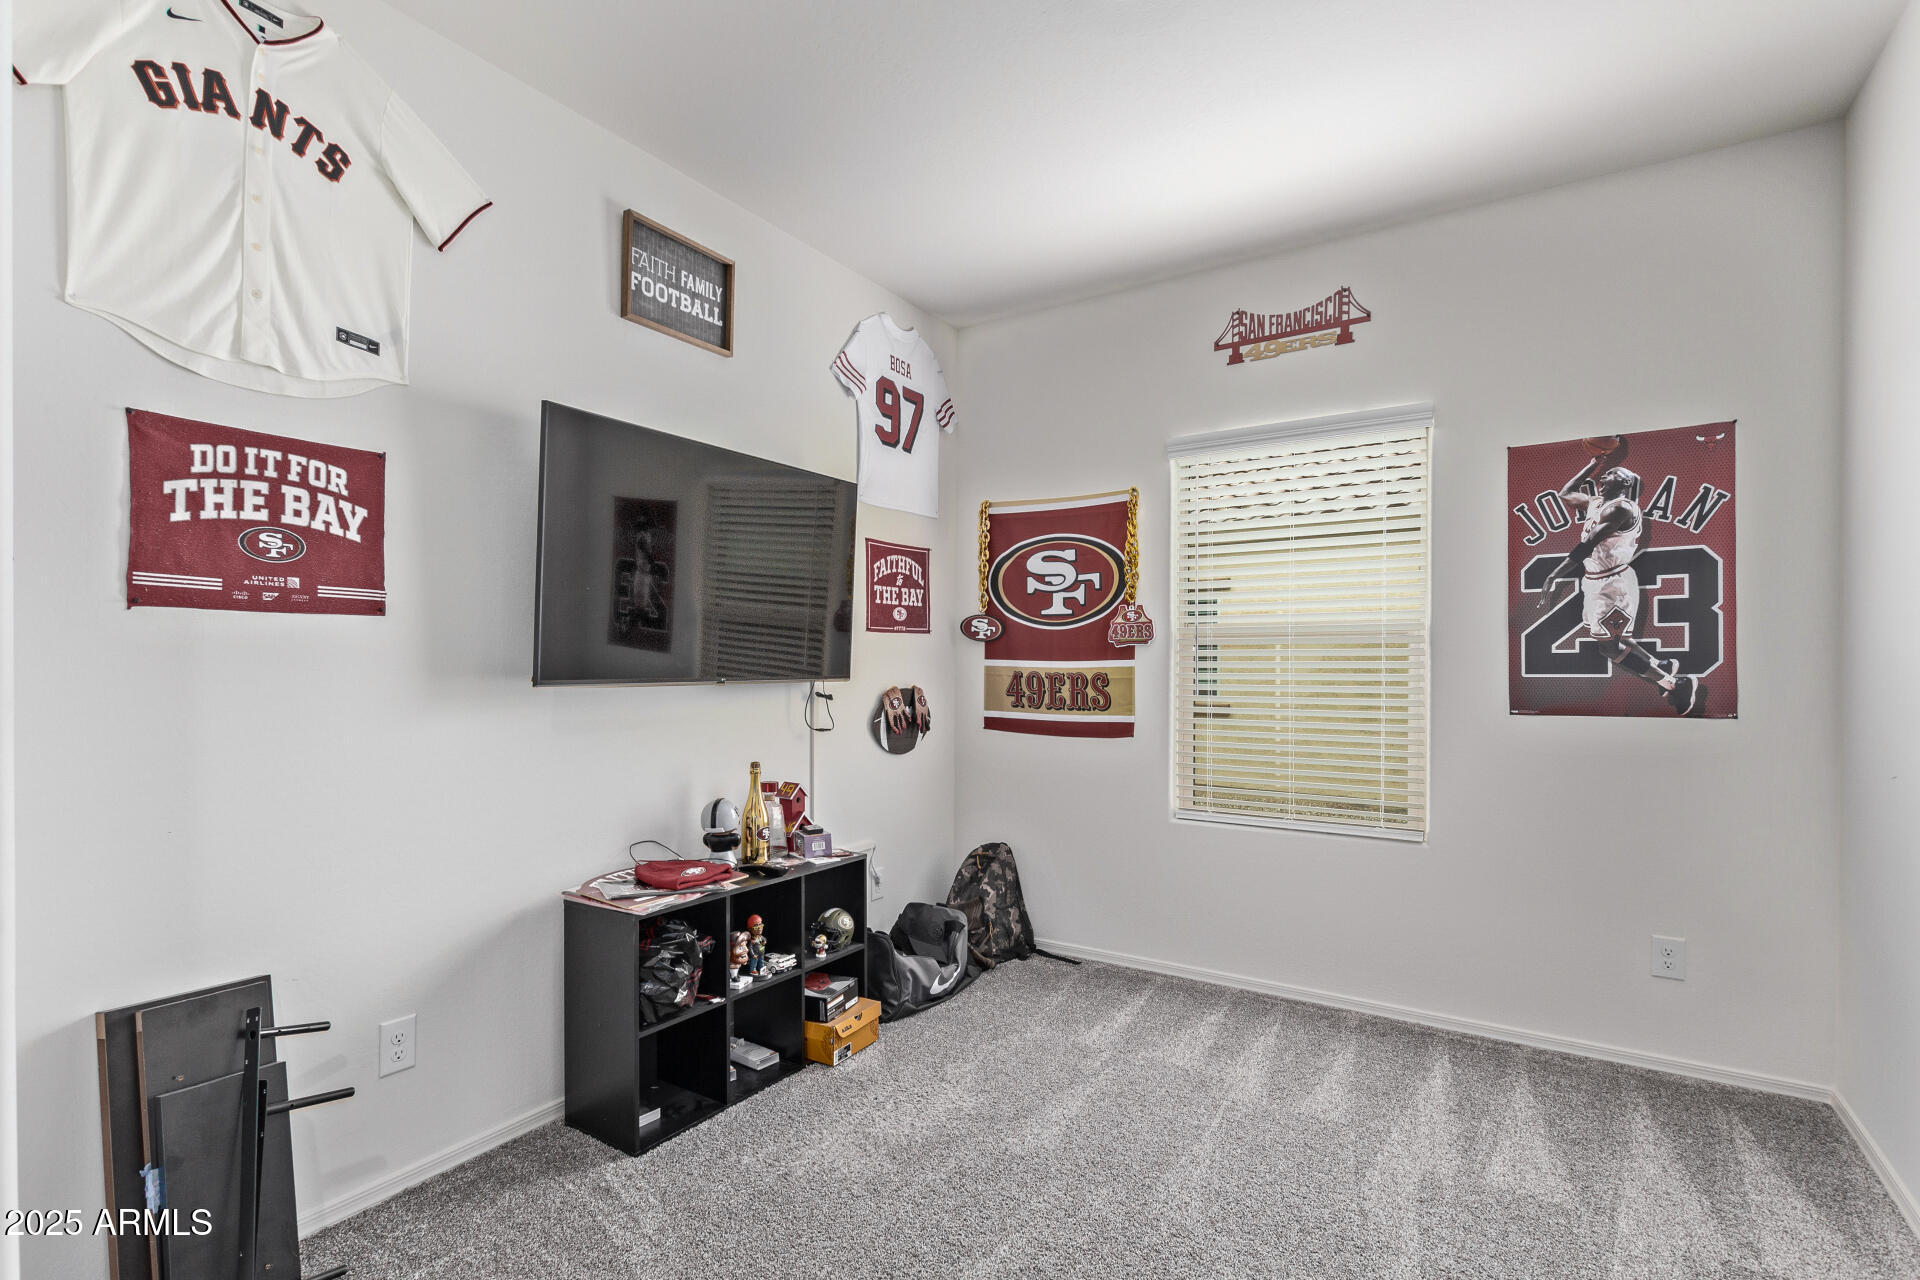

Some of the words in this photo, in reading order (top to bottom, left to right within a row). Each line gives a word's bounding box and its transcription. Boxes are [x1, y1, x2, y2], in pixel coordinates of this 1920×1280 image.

[131, 60, 351, 183] GIANTS
[632, 247, 676, 283] FAITH
[681, 270, 722, 302] FAMILY
[631, 271, 723, 326] FOOTBALL
[1239, 310, 1265, 341] SAN
[1269, 289, 1342, 336] FRANCISCO
[1243, 330, 1337, 362] 49ERS
[890, 354, 912, 380] BOSA
[875, 375, 924, 454] 97
[190, 443, 237, 474] DO
[244, 446, 282, 478] IT
[287, 453, 349, 497] FOR
[163, 478, 269, 522] THE
[280, 484, 368, 543] BAY
[258, 531, 294, 558] SF
[243, 579, 285, 587] AIRLINES
[873, 554, 925, 587] FAITHFUL
[1026, 548, 1102, 616] SF
[873, 584, 900, 605] THE
[901, 587, 924, 607] BAY
[1520, 544, 1723, 678] 23
[970, 618, 996, 639] SF
[1112, 623, 1153, 640] 49ERS
[1006, 671, 1112, 712] 49ERS
[780, 783, 795, 797] 49
